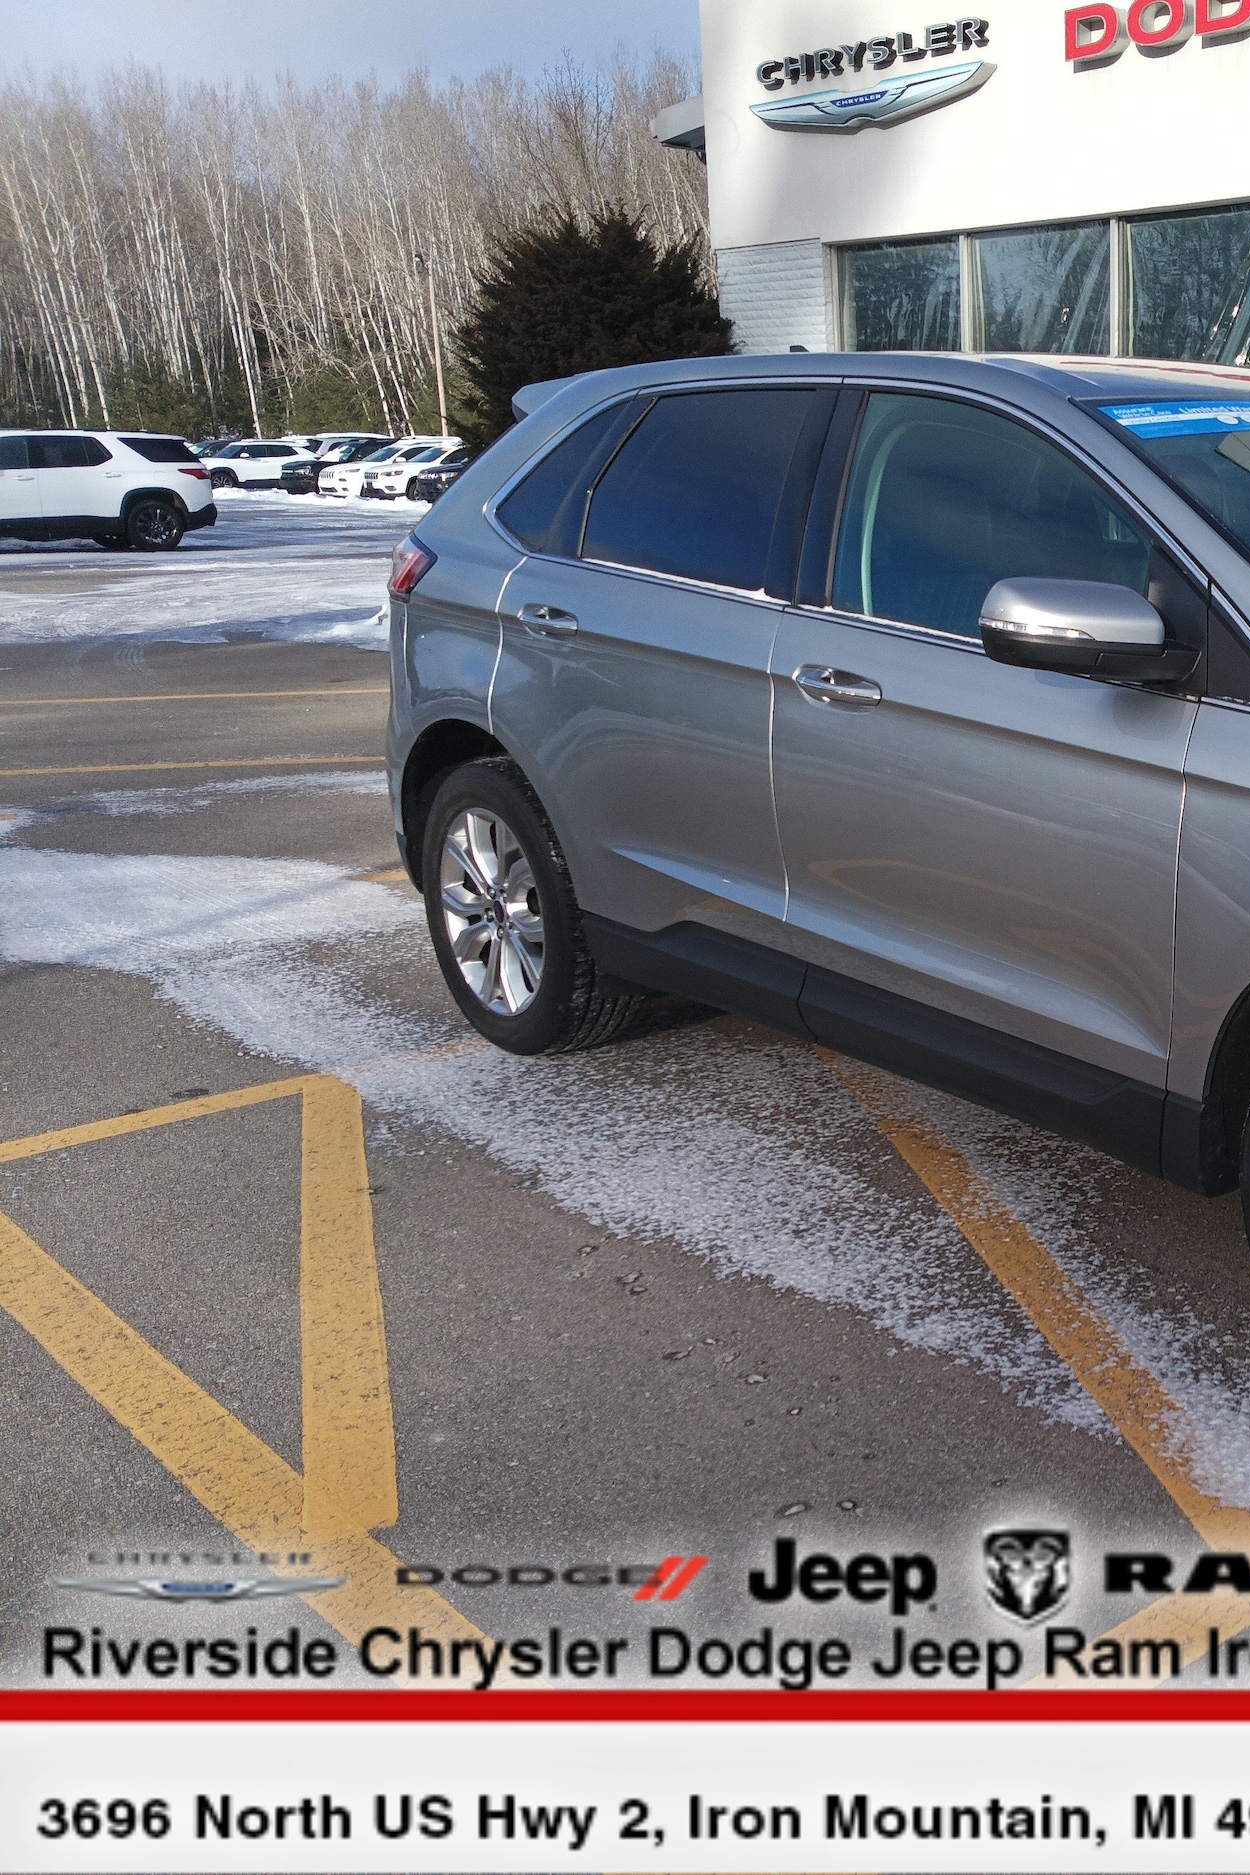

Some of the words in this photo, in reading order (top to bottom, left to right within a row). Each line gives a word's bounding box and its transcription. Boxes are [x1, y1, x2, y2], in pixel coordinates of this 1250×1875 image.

[755, 16, 985, 88] CHRYSLER
[835, 94, 881, 107] CHRYSLER
[1177, 405, 1227, 413] Limited
